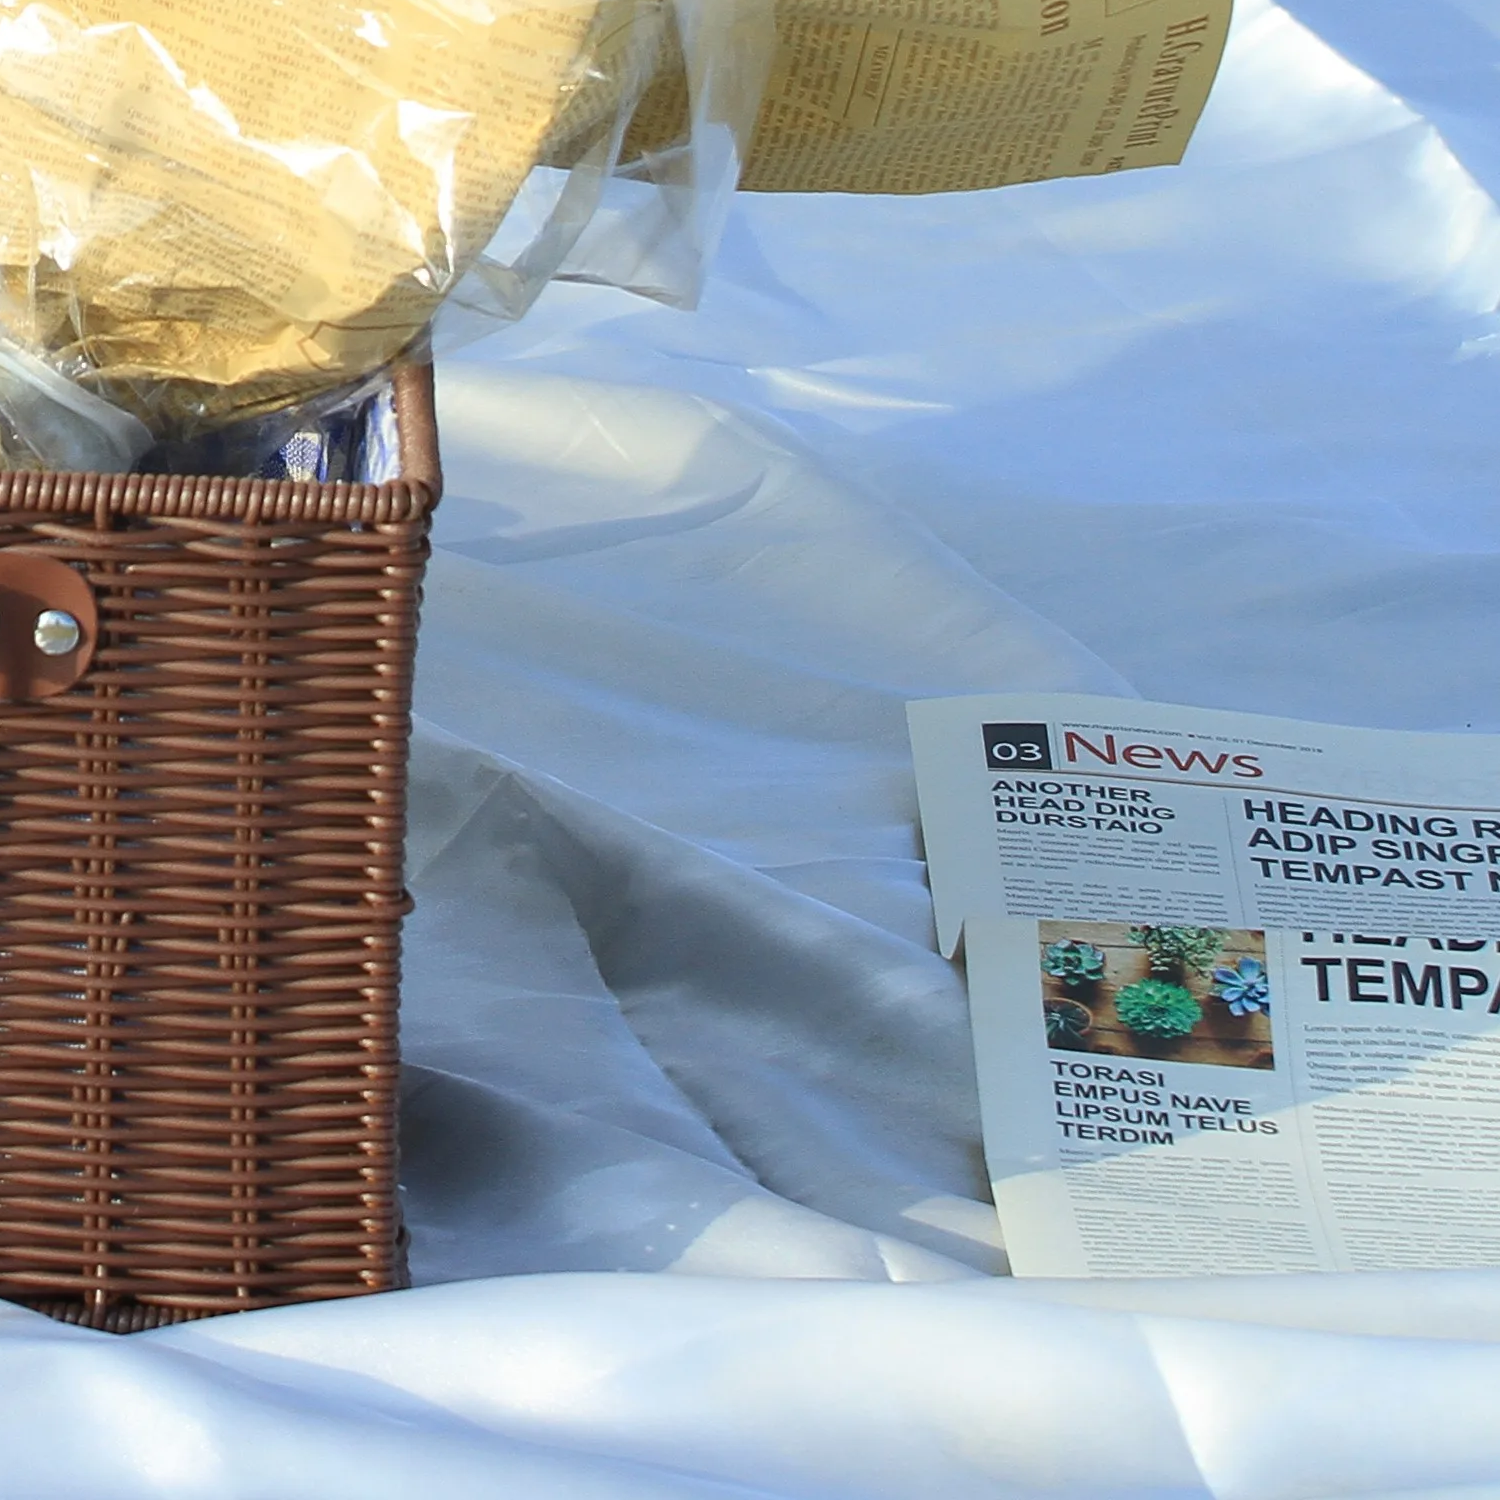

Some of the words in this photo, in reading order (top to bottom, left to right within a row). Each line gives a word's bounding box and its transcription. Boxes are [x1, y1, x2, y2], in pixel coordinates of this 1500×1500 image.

[990, 741, 1043, 762] 03
[1064, 731, 1264, 779] News
[991, 779, 1152, 803] ANOTHER
[994, 794, 1084, 813] HEAD
[1095, 802, 1175, 821] DING
[995, 809, 1163, 835] DURSTAIO
[1243, 798, 1459, 838] HEADING
[1248, 826, 1358, 856] ADIP
[1250, 856, 1474, 892] TEMPAST
[1050, 1060, 1165, 1088] TORASI
[1052, 1080, 1161, 1107] EMPUS
[1170, 1093, 1252, 1116] NAVE
[1055, 1100, 1170, 1127] LIPSUM
[1178, 1112, 1279, 1135] TELUS
[1056, 1121, 1175, 1146] TERDIM
